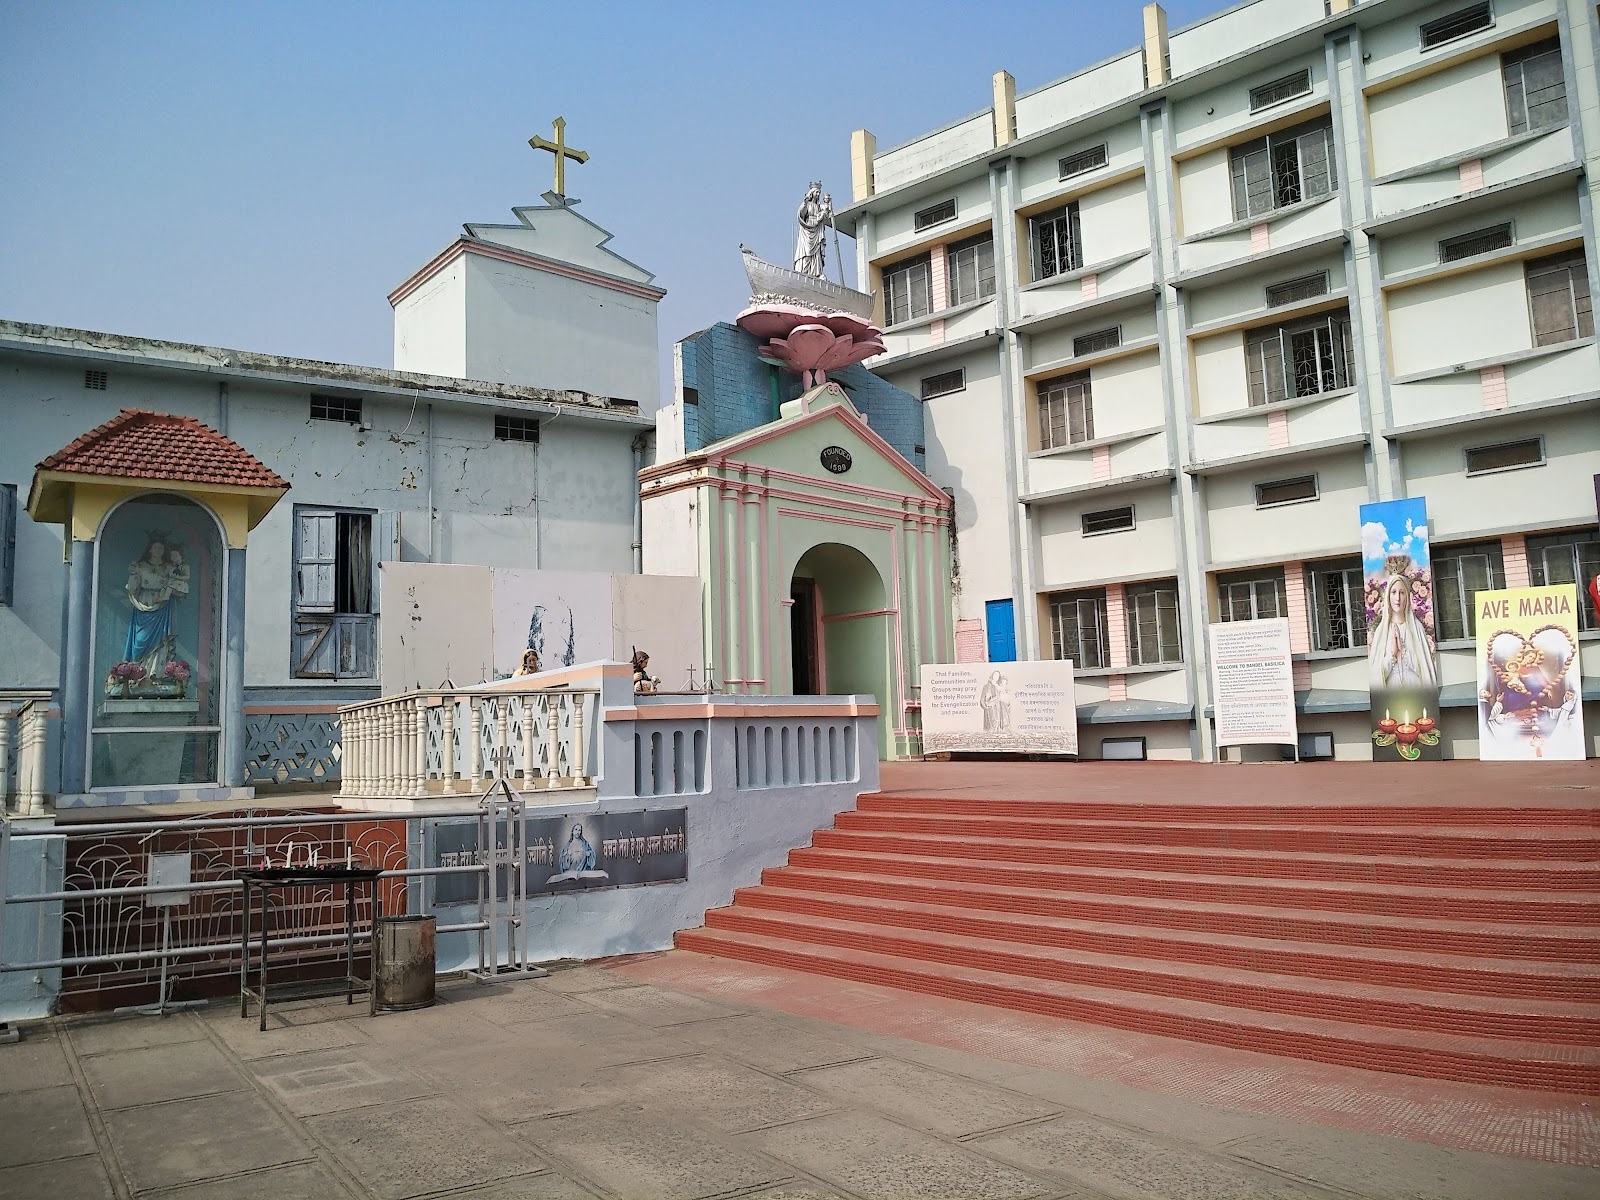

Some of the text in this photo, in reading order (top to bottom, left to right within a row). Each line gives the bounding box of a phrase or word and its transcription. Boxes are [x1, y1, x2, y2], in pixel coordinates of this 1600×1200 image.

[823, 448, 851, 460] FOUNDED
[1482, 595, 1571, 619] AVE MARIA
